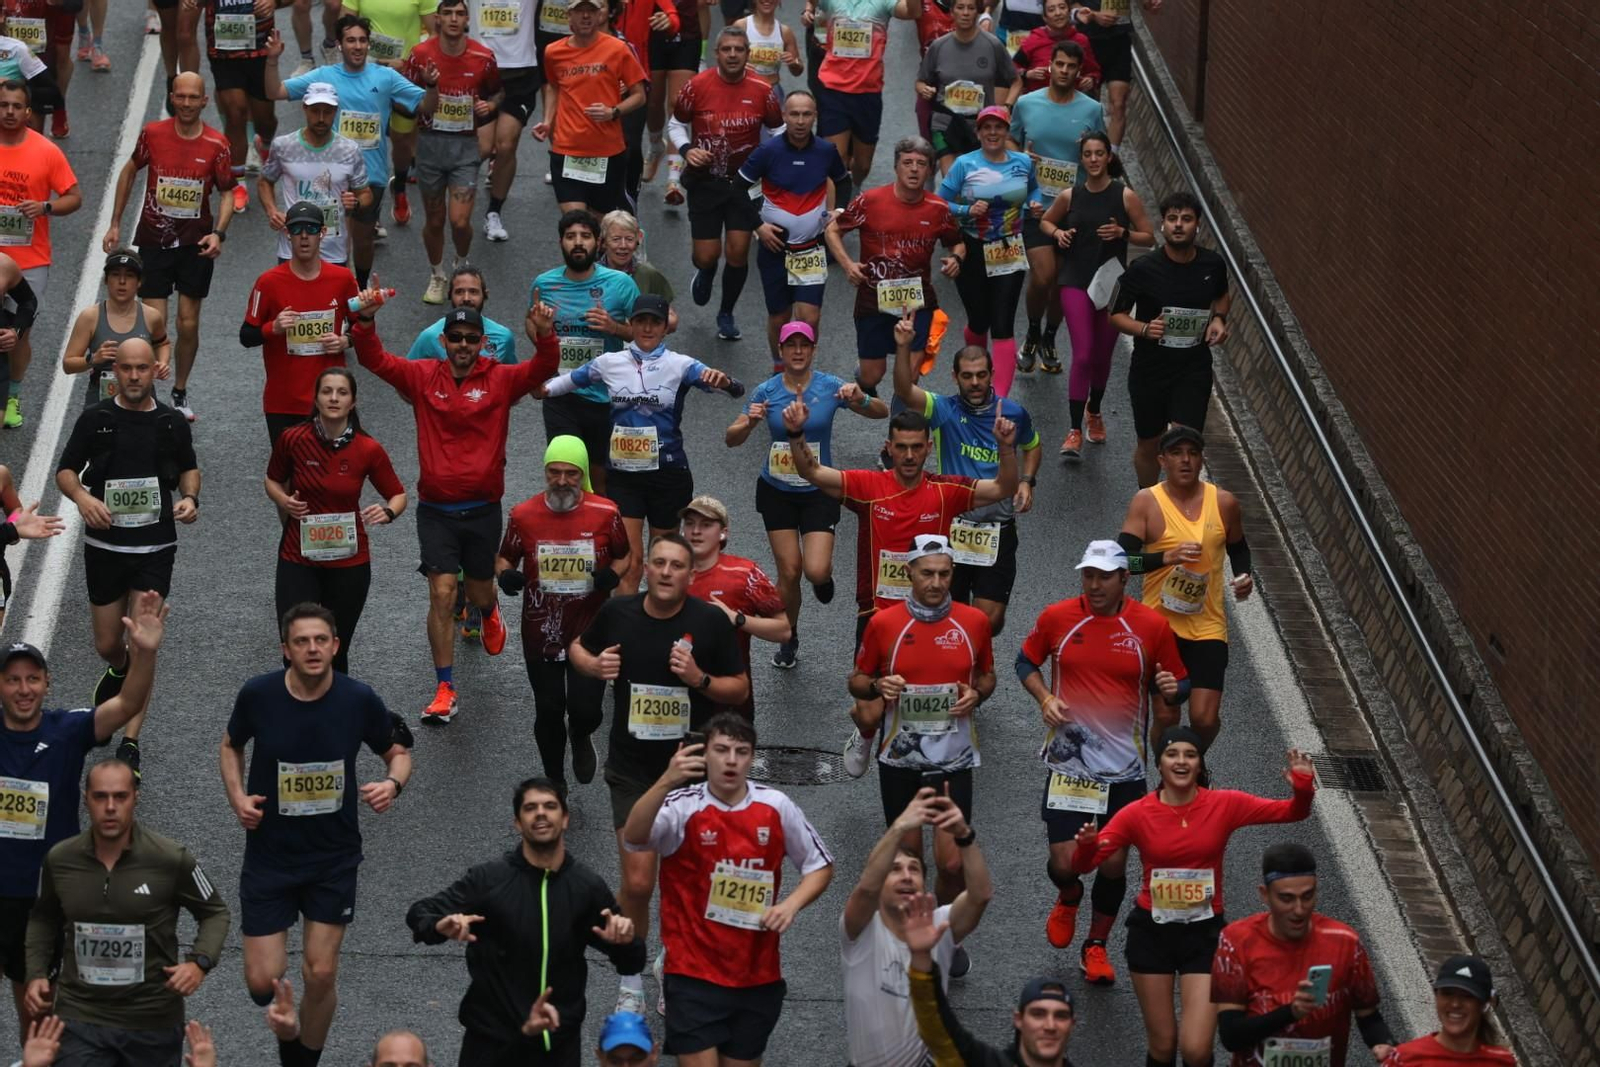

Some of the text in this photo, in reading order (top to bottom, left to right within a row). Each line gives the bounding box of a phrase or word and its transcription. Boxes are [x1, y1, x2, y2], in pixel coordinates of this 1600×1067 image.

[483, 10, 512, 21] 11781
[220, 23, 246, 34] 8450
[837, 31, 865, 42] 14327
[343, 120, 376, 134] 11875
[1040, 166, 1070, 183] 13896
[161, 187, 197, 202] 14462
[788, 255, 820, 271] 12393
[882, 288, 916, 302] 13076
[293, 322, 329, 337] 10836
[1169, 317, 1197, 330] 8281
[561, 347, 592, 361] 8984
[614, 437, 650, 452] 10826
[113, 491, 148, 506] 9025
[309, 526, 343, 542] 9026
[951, 529, 992, 546] 15167
[543, 557, 585, 572] 12770
[635, 698, 680, 716] 12308
[904, 697, 950, 713] 10424
[284, 775, 335, 793] 15032
[718, 880, 766, 903] 12115
[1157, 883, 1203, 900] 11155
[81, 939, 133, 958] 17292
